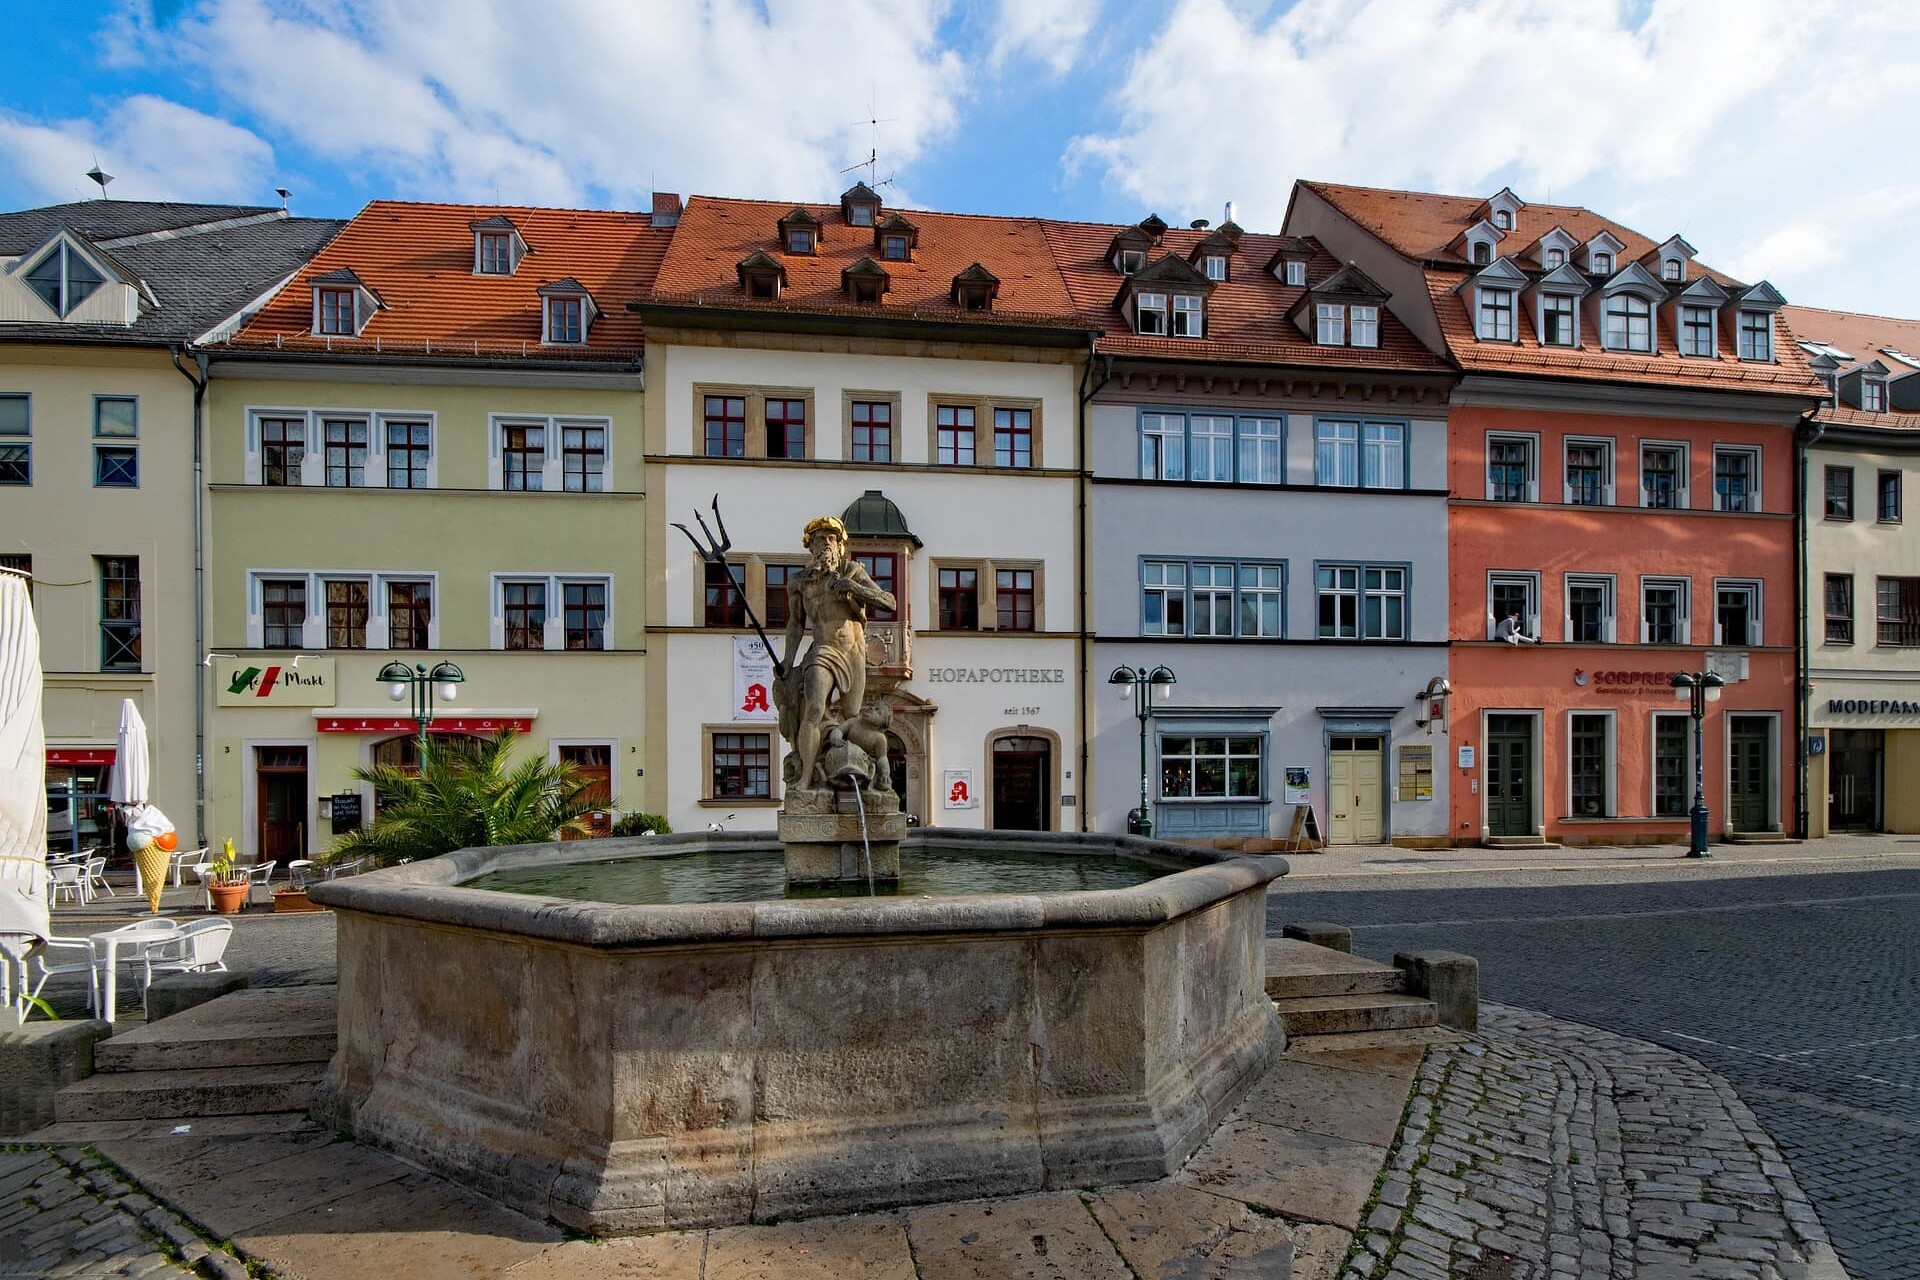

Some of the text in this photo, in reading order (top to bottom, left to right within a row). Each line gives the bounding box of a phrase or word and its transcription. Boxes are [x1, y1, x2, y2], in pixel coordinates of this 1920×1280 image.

[284, 671, 325, 686] Markt
[928, 667, 1065, 683] HOFAPOTHEKE
[1593, 671, 1674, 685] SORPRES
[1004, 706, 1040, 715] seit 1567
[224, 746, 230, 754] 3
